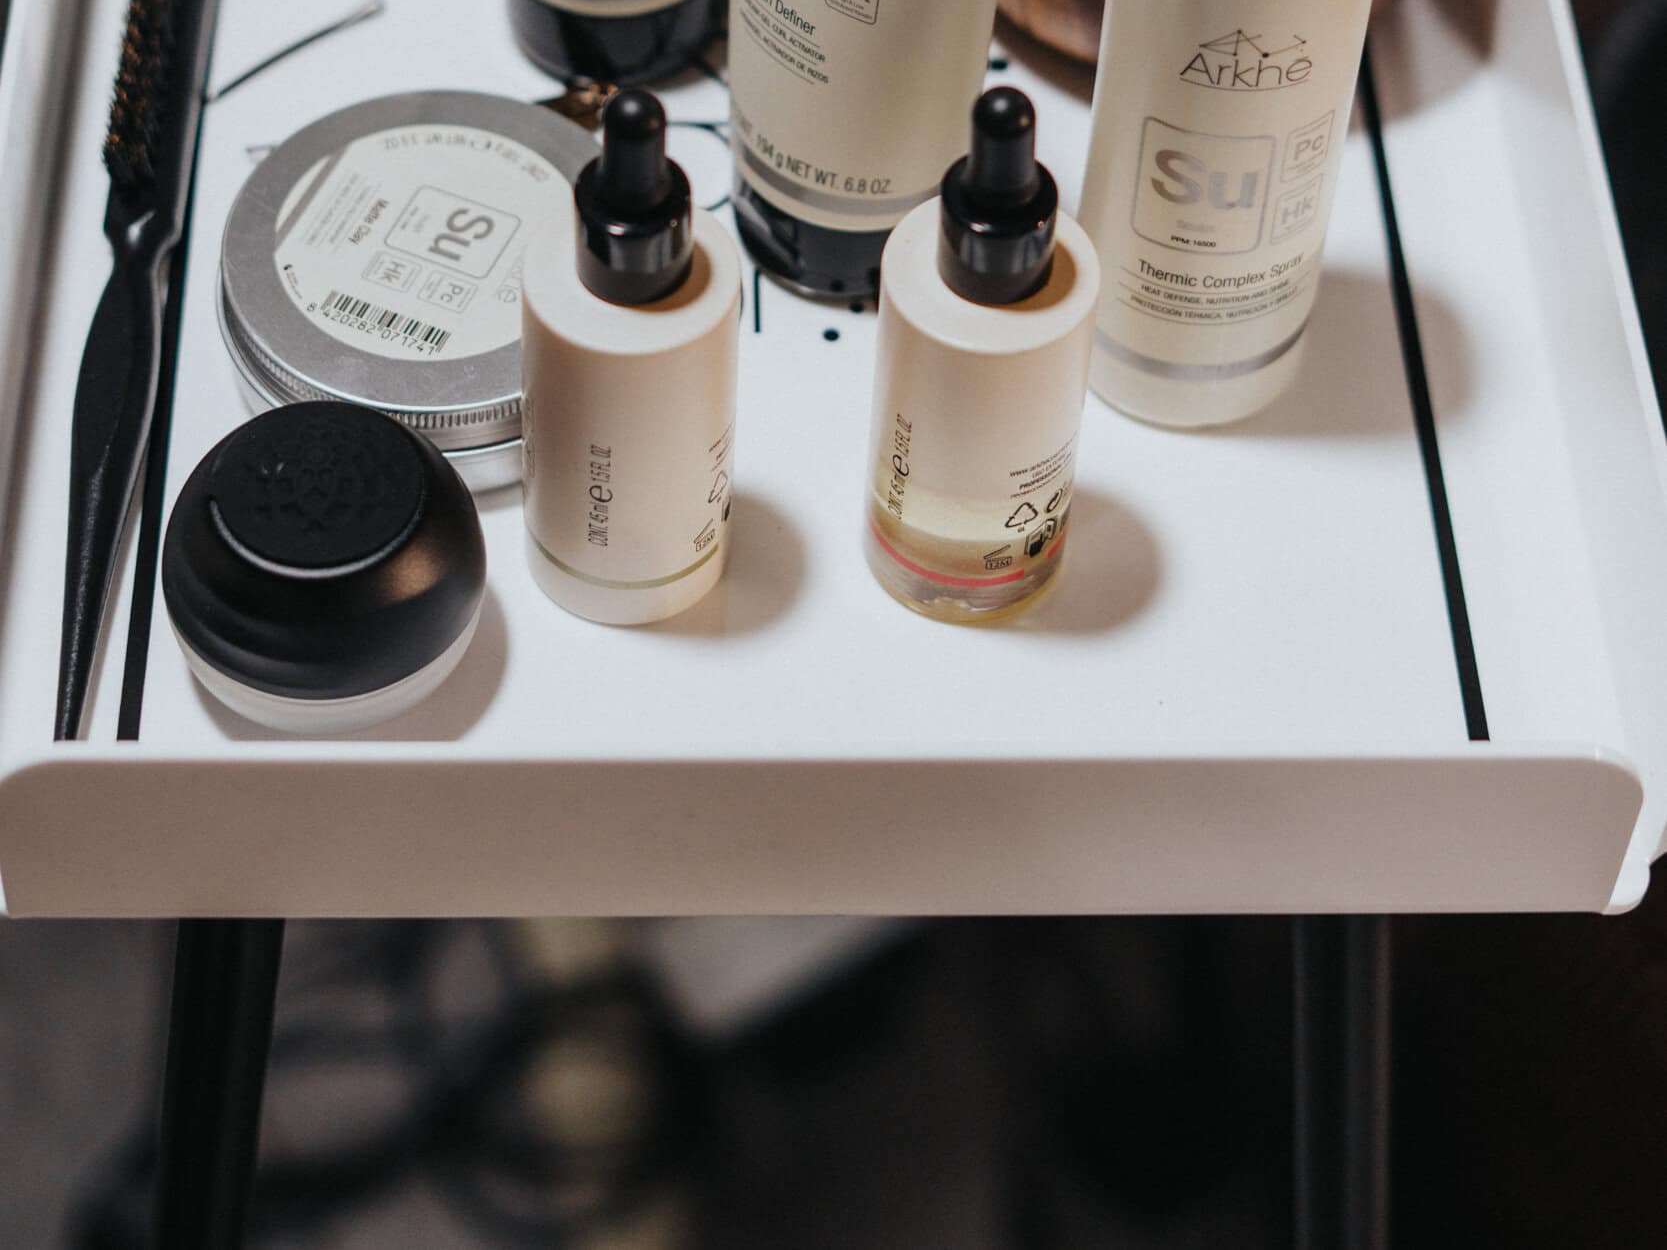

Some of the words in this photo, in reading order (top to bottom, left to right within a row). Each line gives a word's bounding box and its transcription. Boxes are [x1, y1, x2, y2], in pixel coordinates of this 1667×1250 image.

[786, 153, 812, 180] NET
[1149, 148, 1260, 210] Su
[428, 207, 496, 263] Su
[438, 283, 466, 304] Pc
[1138, 258, 1198, 287] Thermic
[1202, 270, 1266, 294] Complex
[1269, 252, 1307, 282] Spray
[321, 310, 377, 335] 420282
[380, 328, 438, 356] 071741
